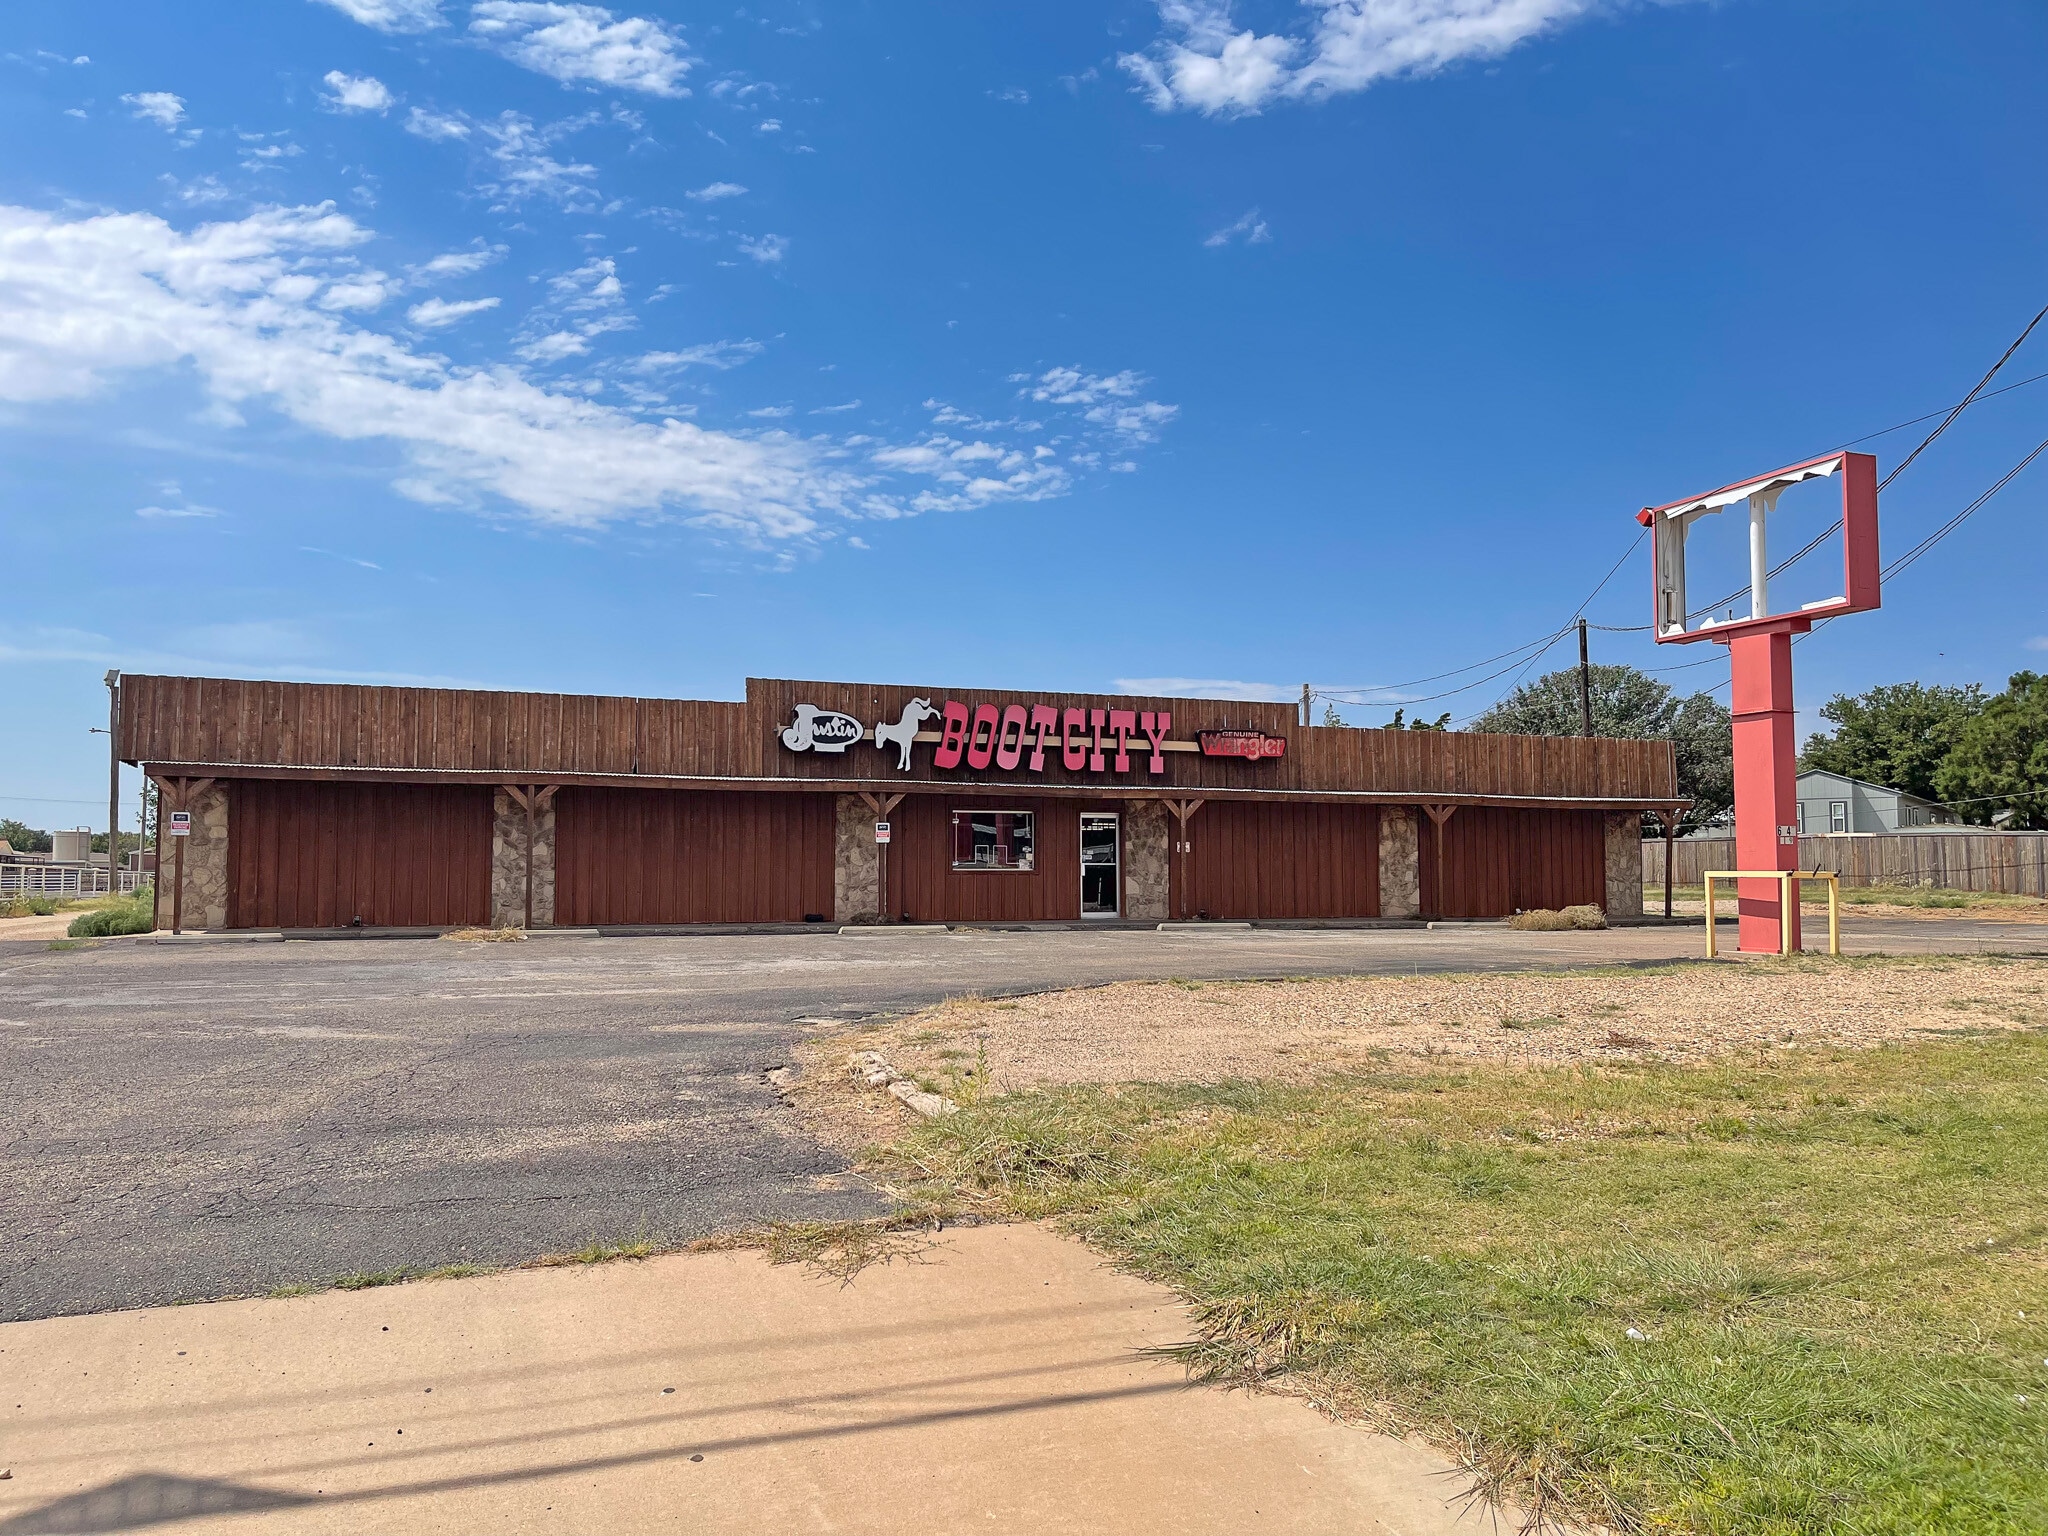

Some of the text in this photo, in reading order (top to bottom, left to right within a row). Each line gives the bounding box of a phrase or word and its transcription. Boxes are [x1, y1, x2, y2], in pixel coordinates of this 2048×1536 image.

[783, 704, 857, 751] Justin
[934, 700, 1171, 773] BOOT CITY
